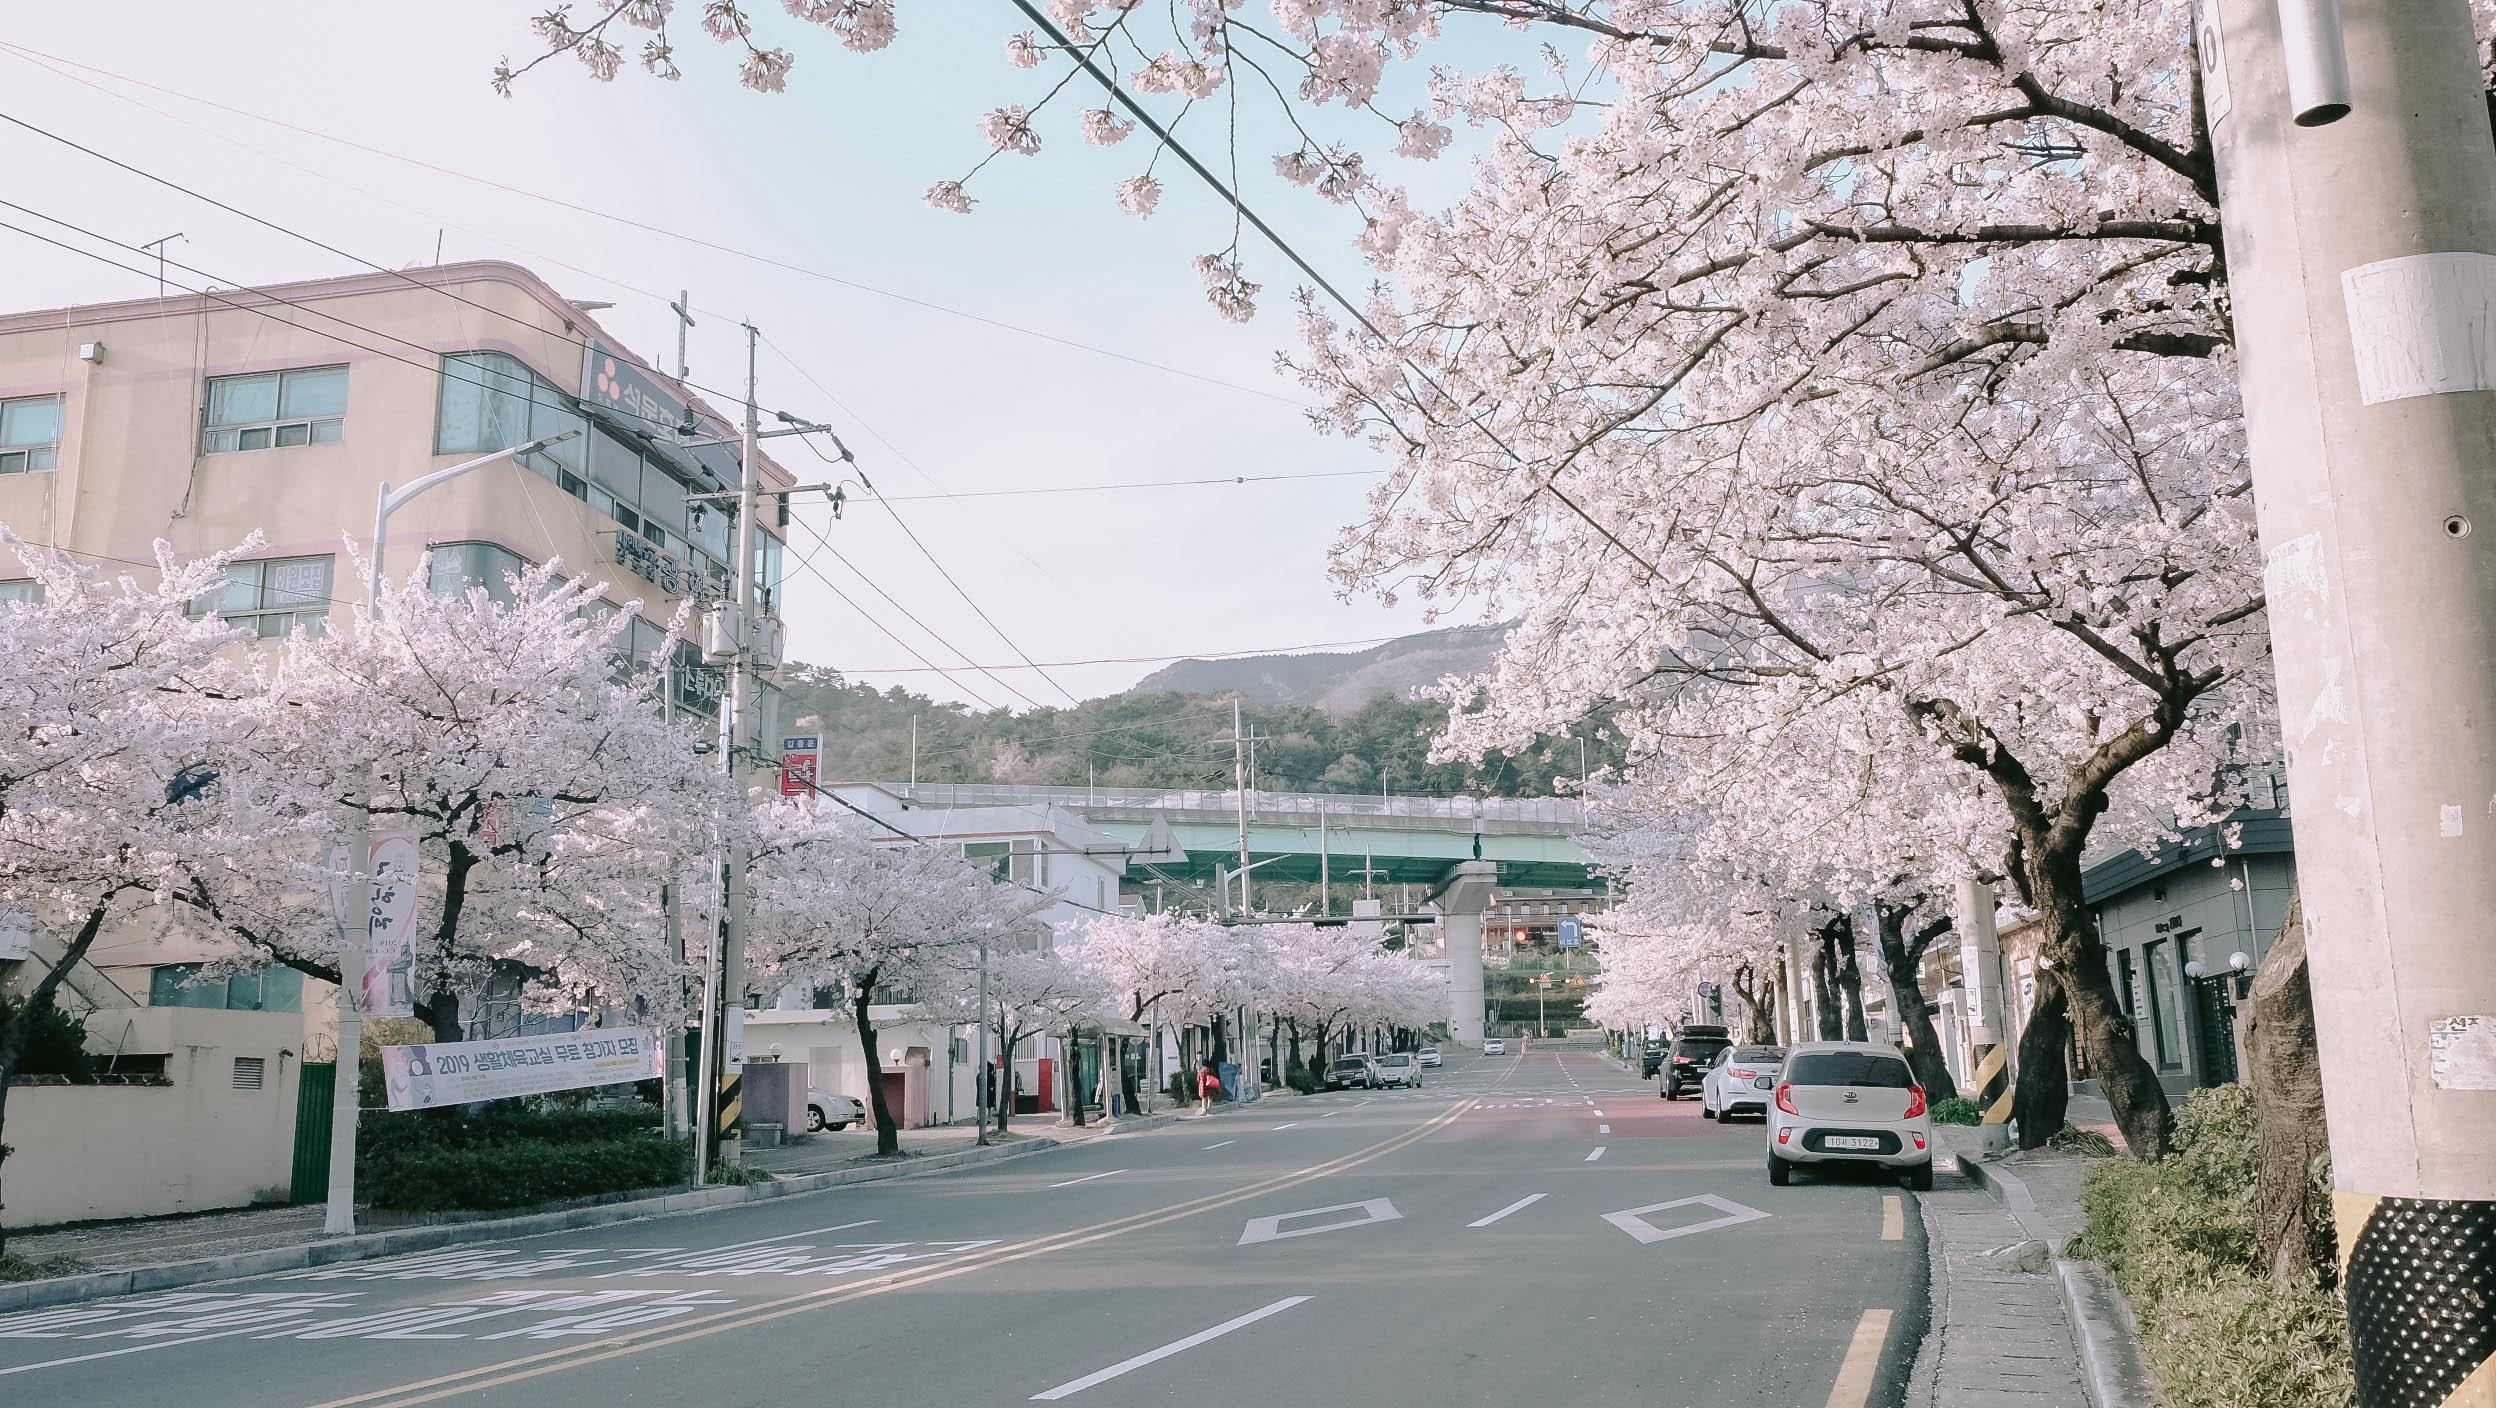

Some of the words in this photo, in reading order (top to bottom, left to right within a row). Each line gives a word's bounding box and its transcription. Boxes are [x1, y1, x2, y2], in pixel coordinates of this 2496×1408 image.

[436, 1055, 470, 1075] 2019
[474, 1046, 555, 1071] 생활체육교실
[555, 1043, 582, 1062] 무료
[583, 1040, 617, 1060] 참가자
[618, 1037, 639, 1056] 모집
[1852, 1138, 1874, 1148] 3122
